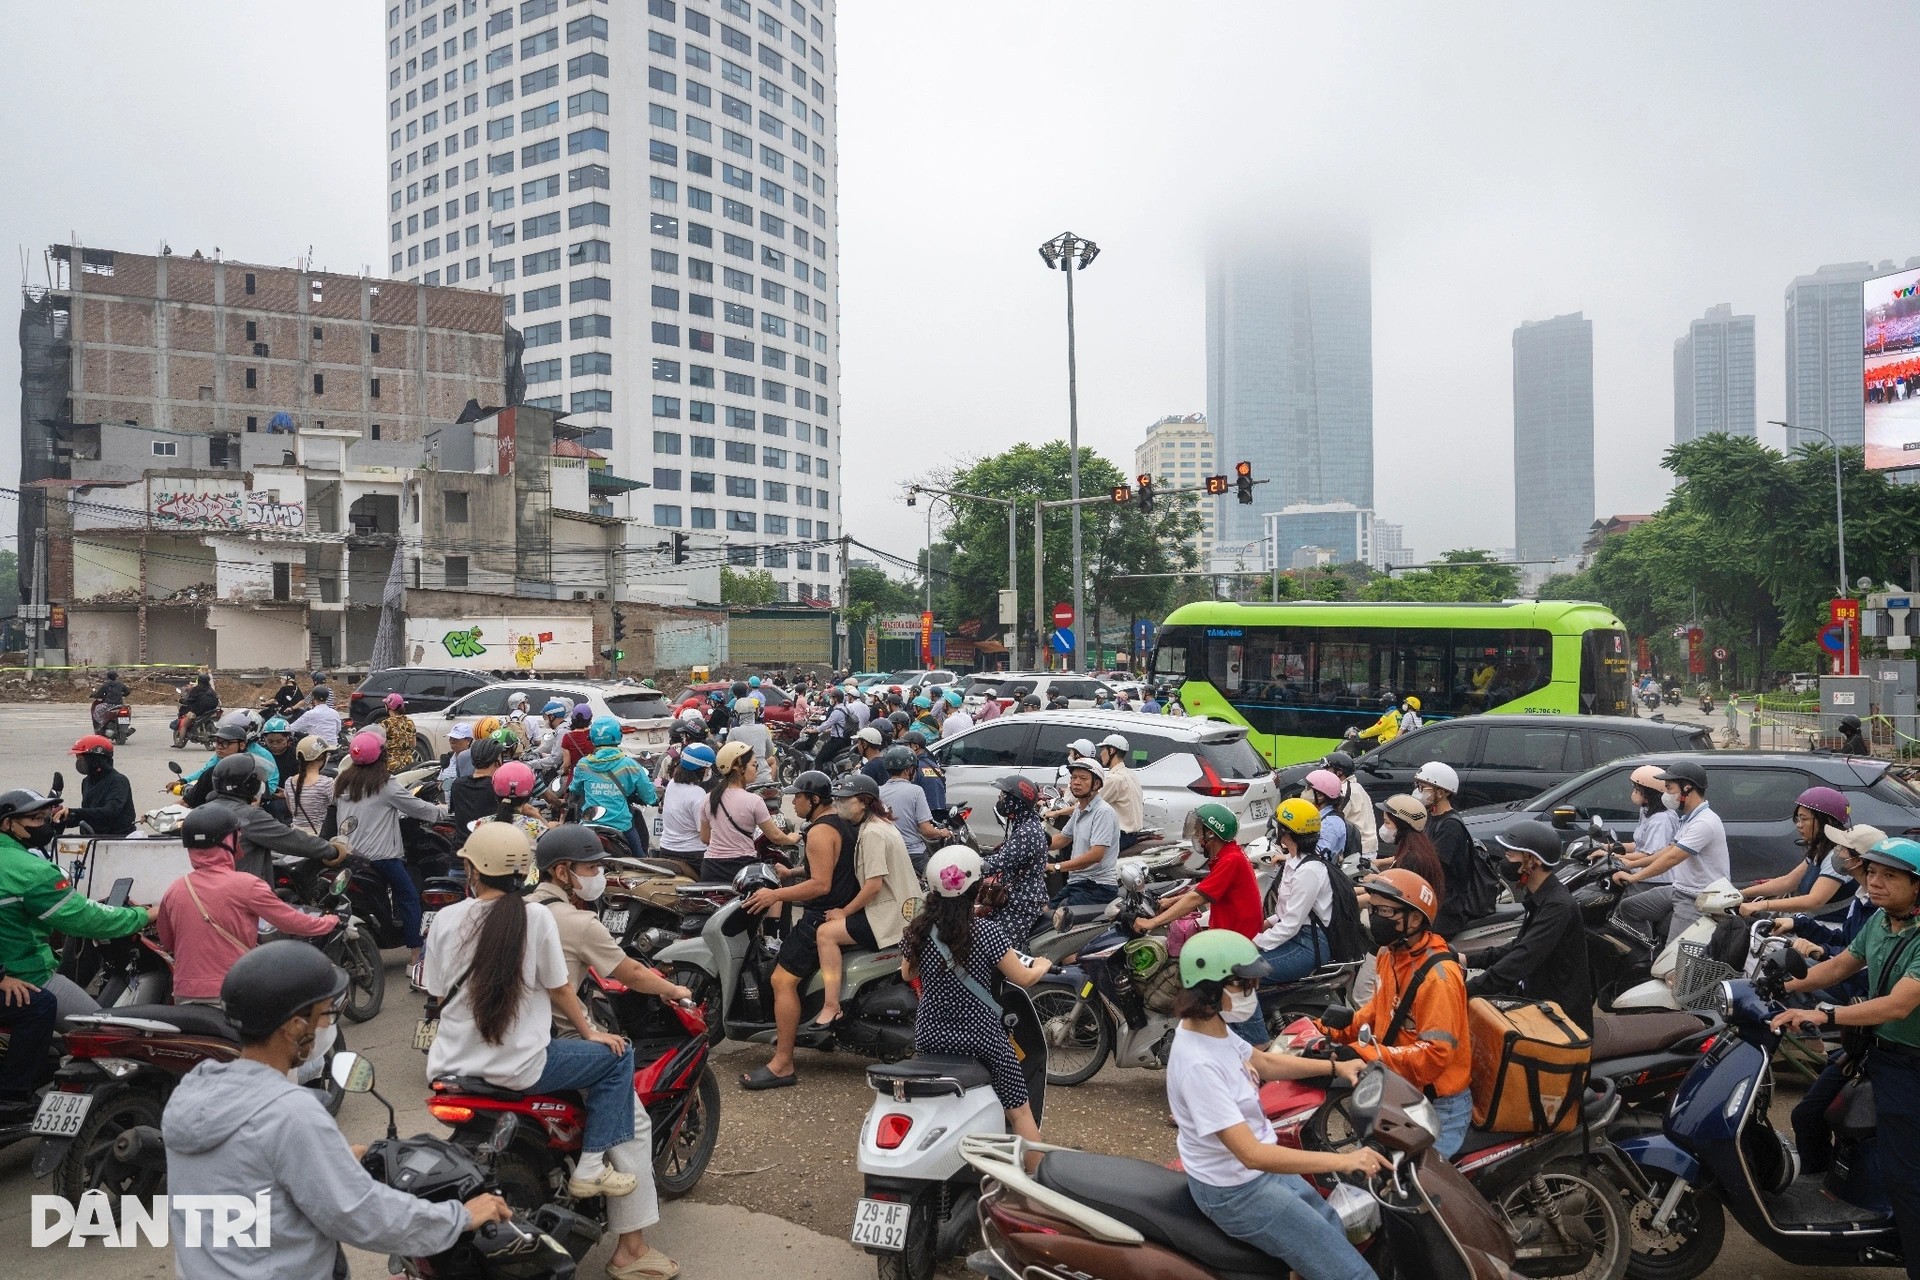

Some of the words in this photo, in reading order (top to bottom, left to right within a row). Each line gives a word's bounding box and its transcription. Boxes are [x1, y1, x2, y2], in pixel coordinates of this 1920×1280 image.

[1115, 489, 1129, 501] 21
[1210, 480, 1226, 492] 21
[442, 631, 487, 658] CK
[1282, 807, 1294, 821] be
[1208, 816, 1226, 833] Grab
[46, 1095, 84, 1114] 20-B1
[531, 1102, 566, 1111] 150
[34, 1113, 81, 1132] 533.85
[862, 1202, 903, 1225] 29-AF
[854, 1222, 903, 1247] 240.92
